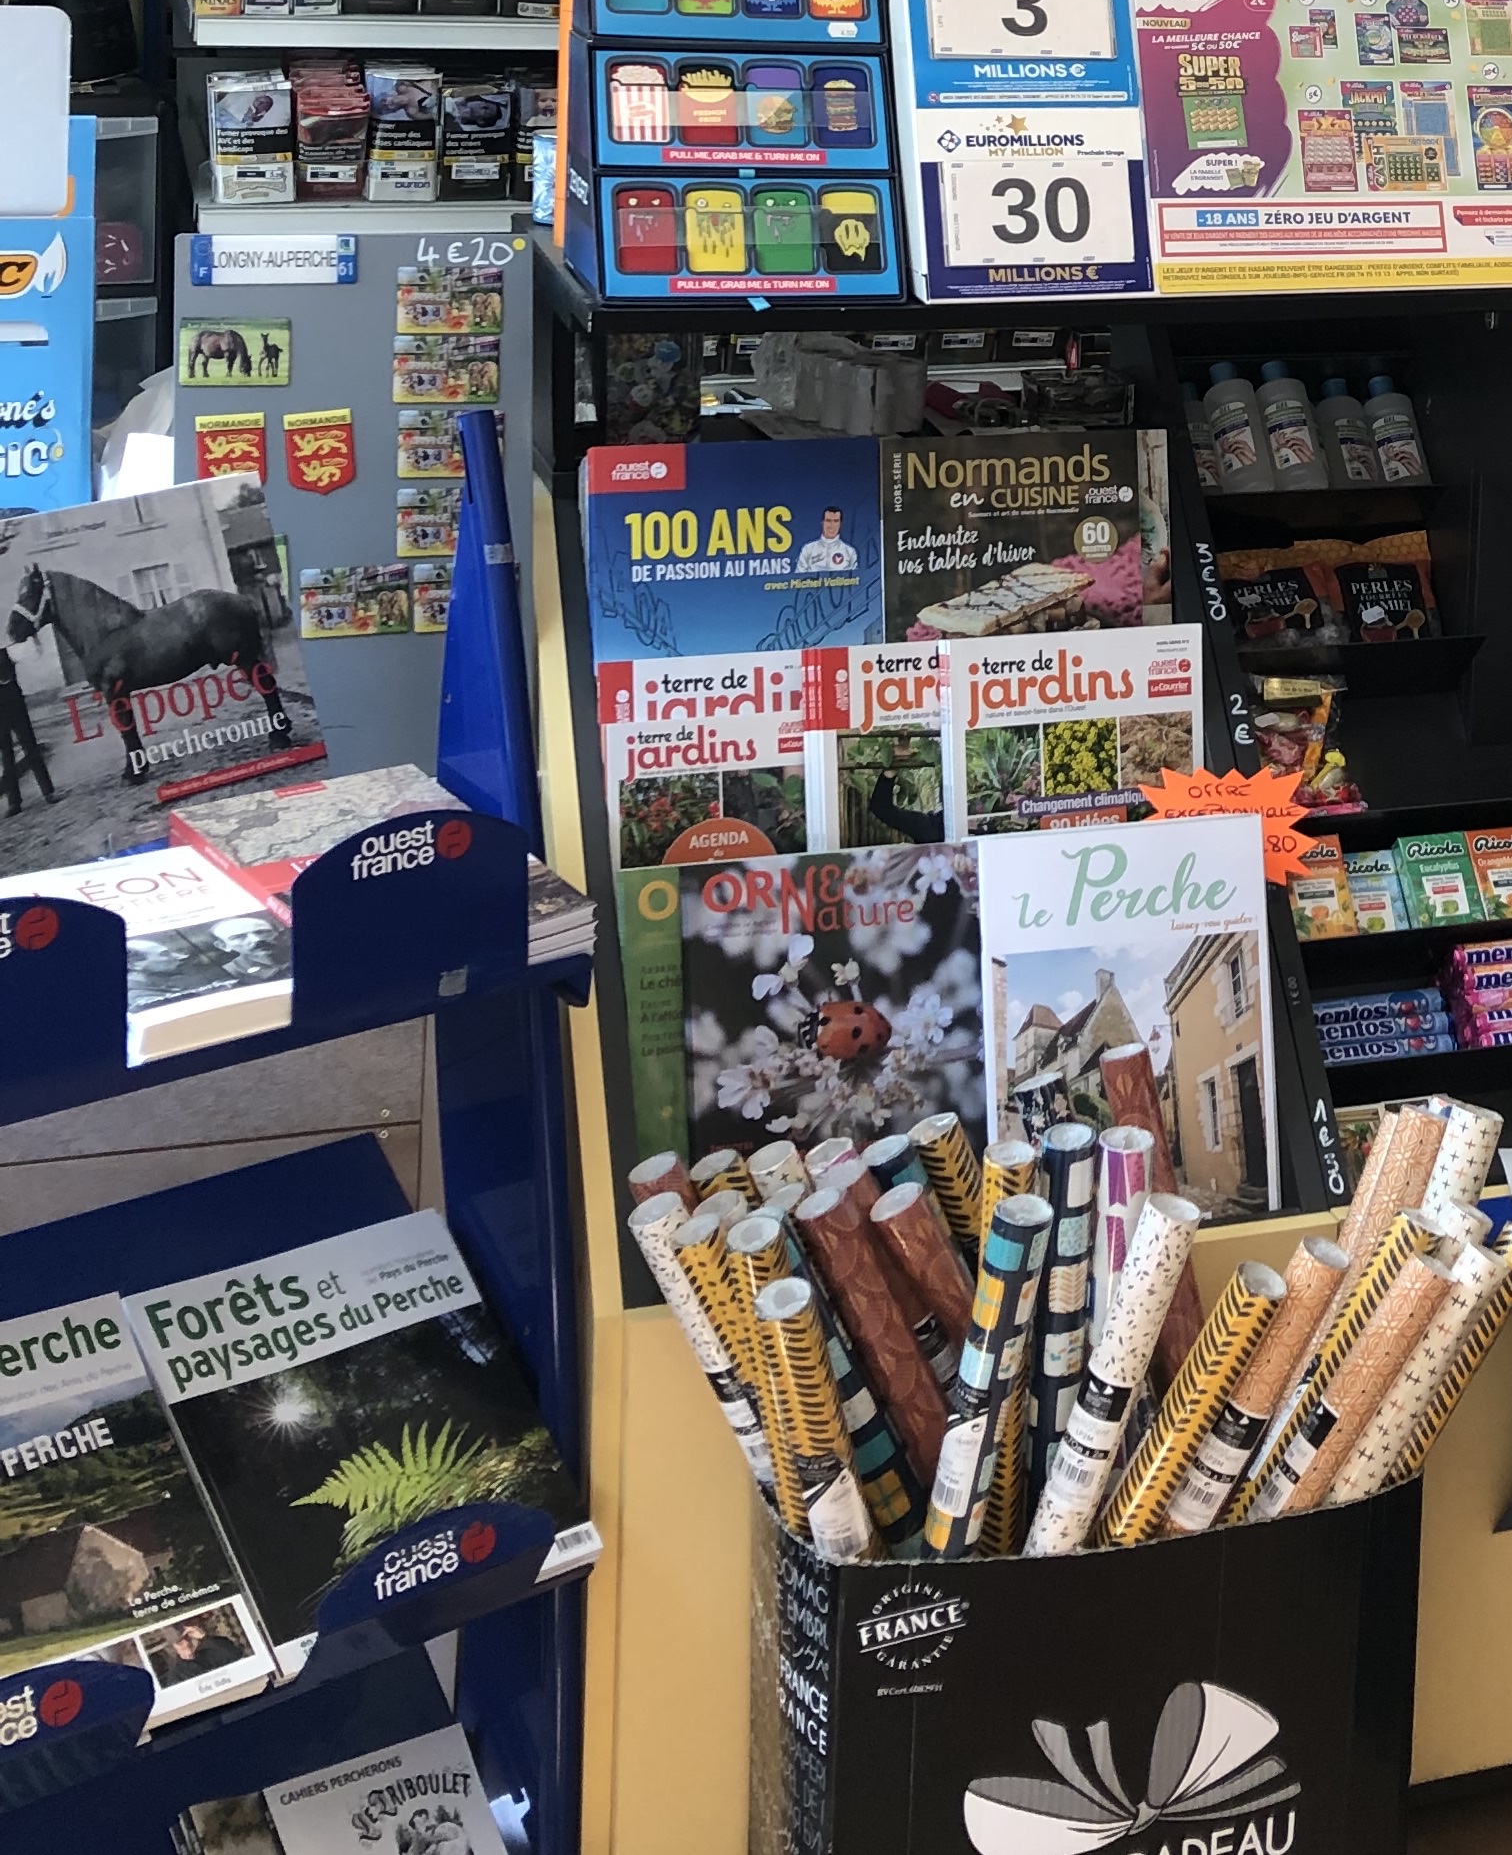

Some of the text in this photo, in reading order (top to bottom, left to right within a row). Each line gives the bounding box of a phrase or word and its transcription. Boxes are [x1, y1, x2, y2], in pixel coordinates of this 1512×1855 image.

[1142, 19, 1188, 28] NOUVEAU
[1165, 31, 1261, 43] MEILLEURE CHANCE
[973, 63, 1068, 79] MILLIONS
[1178, 53, 1242, 77] SUPER
[964, 133, 1085, 149] EUROMILLIONS
[988, 147, 1065, 157] MY MILLION
[990, 176, 1092, 245] 30
[1197, 211, 1223, 225] -18
[1225, 211, 1258, 225] ANS
[1263, 208, 1303, 225] ZÉRO
[1307, 211, 1335, 225] JEU
[212, 250, 337, 270] LONGNY-AU-PERCHE
[988, 265, 1085, 283] MILLIONS
[199, 416, 262, 429] NORMANDIE
[906, 442, 1112, 491] Normands
[950, 484, 1081, 509] en CUISINE
[624, 505, 793, 561] 100 ANS
[897, 524, 980, 553] Enchantez
[1081, 520, 1111, 545] 60
[631, 557, 792, 583] DE PASSION AU MANS
[898, 556, 925, 575] vos
[926, 549, 978, 574] tables
[763, 576, 861, 592] avec Michel Vaillant
[1350, 579, 1413, 595] PERLES
[981, 650, 1054, 676] terre de
[967, 649, 1135, 728] jardins
[128, 708, 289, 775] percheronne
[1020, 793, 1092, 815] Changement
[360, 819, 436, 857] ouest
[688, 829, 750, 850] AGENDA
[1405, 840, 1463, 859] Ricola
[350, 843, 436, 881] france
[1419, 861, 1461, 873] Eucalyptus
[1061, 843, 1238, 927] Perche
[143, 1269, 348, 1351] Forêts et
[169, 1272, 465, 1394] paysages du Perche
[2, 1417, 115, 1478] PERCHE
[871, 1582, 944, 1616] ORIGINE
[858, 1601, 965, 1646] FRANCE
[875, 1632, 955, 1671] GARANTIE
[279, 1755, 403, 1806] CAHIERS PERCHERONS
